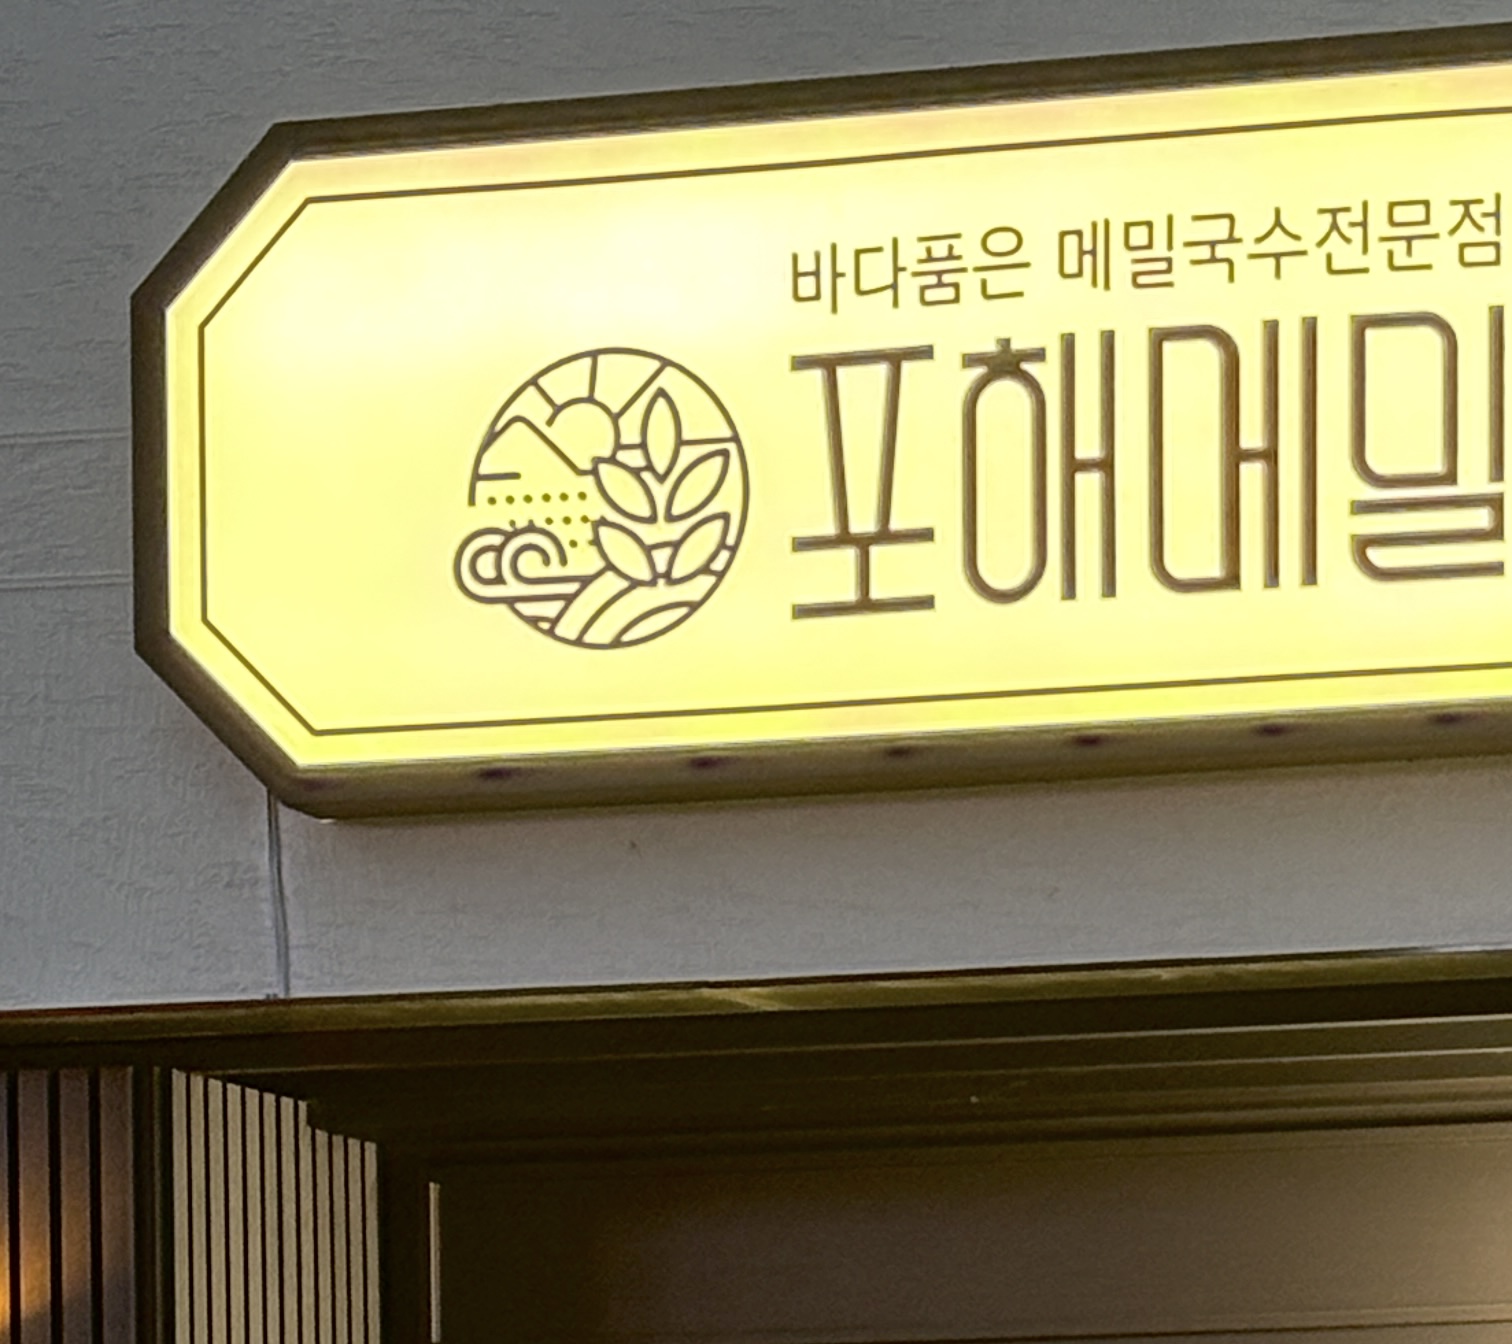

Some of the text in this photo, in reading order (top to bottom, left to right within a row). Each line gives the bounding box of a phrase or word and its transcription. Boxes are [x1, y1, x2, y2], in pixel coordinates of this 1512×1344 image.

[789, 192, 1504, 315] 바다품은 메밀국수전문점
[790, 305, 1505, 621] 포해메밀
